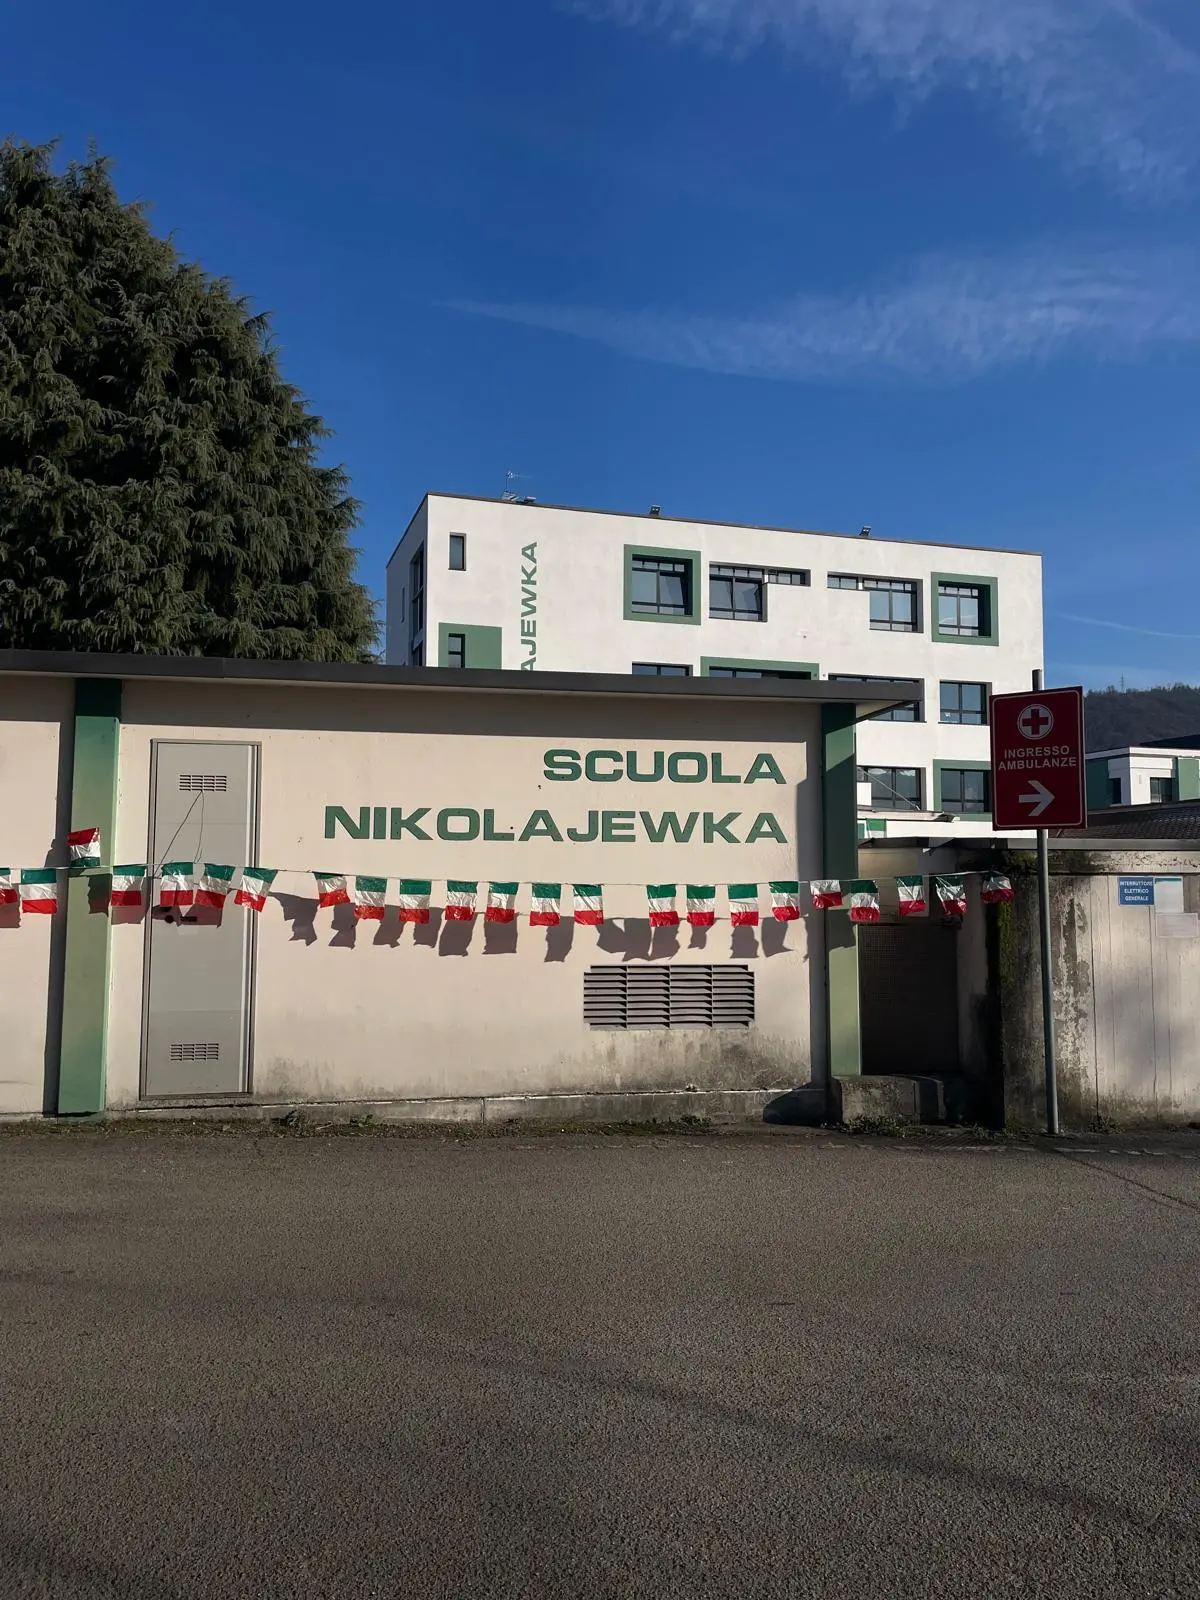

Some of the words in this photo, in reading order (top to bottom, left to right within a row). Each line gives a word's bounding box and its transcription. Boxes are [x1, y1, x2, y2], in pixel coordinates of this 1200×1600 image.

[998, 757, 1076, 770] AMBULANZE
[1004, 745, 1070, 758] INGRESSO
[543, 749, 787, 784] SCUOLA
[324, 805, 788, 844] NIKOLAJEWKA
